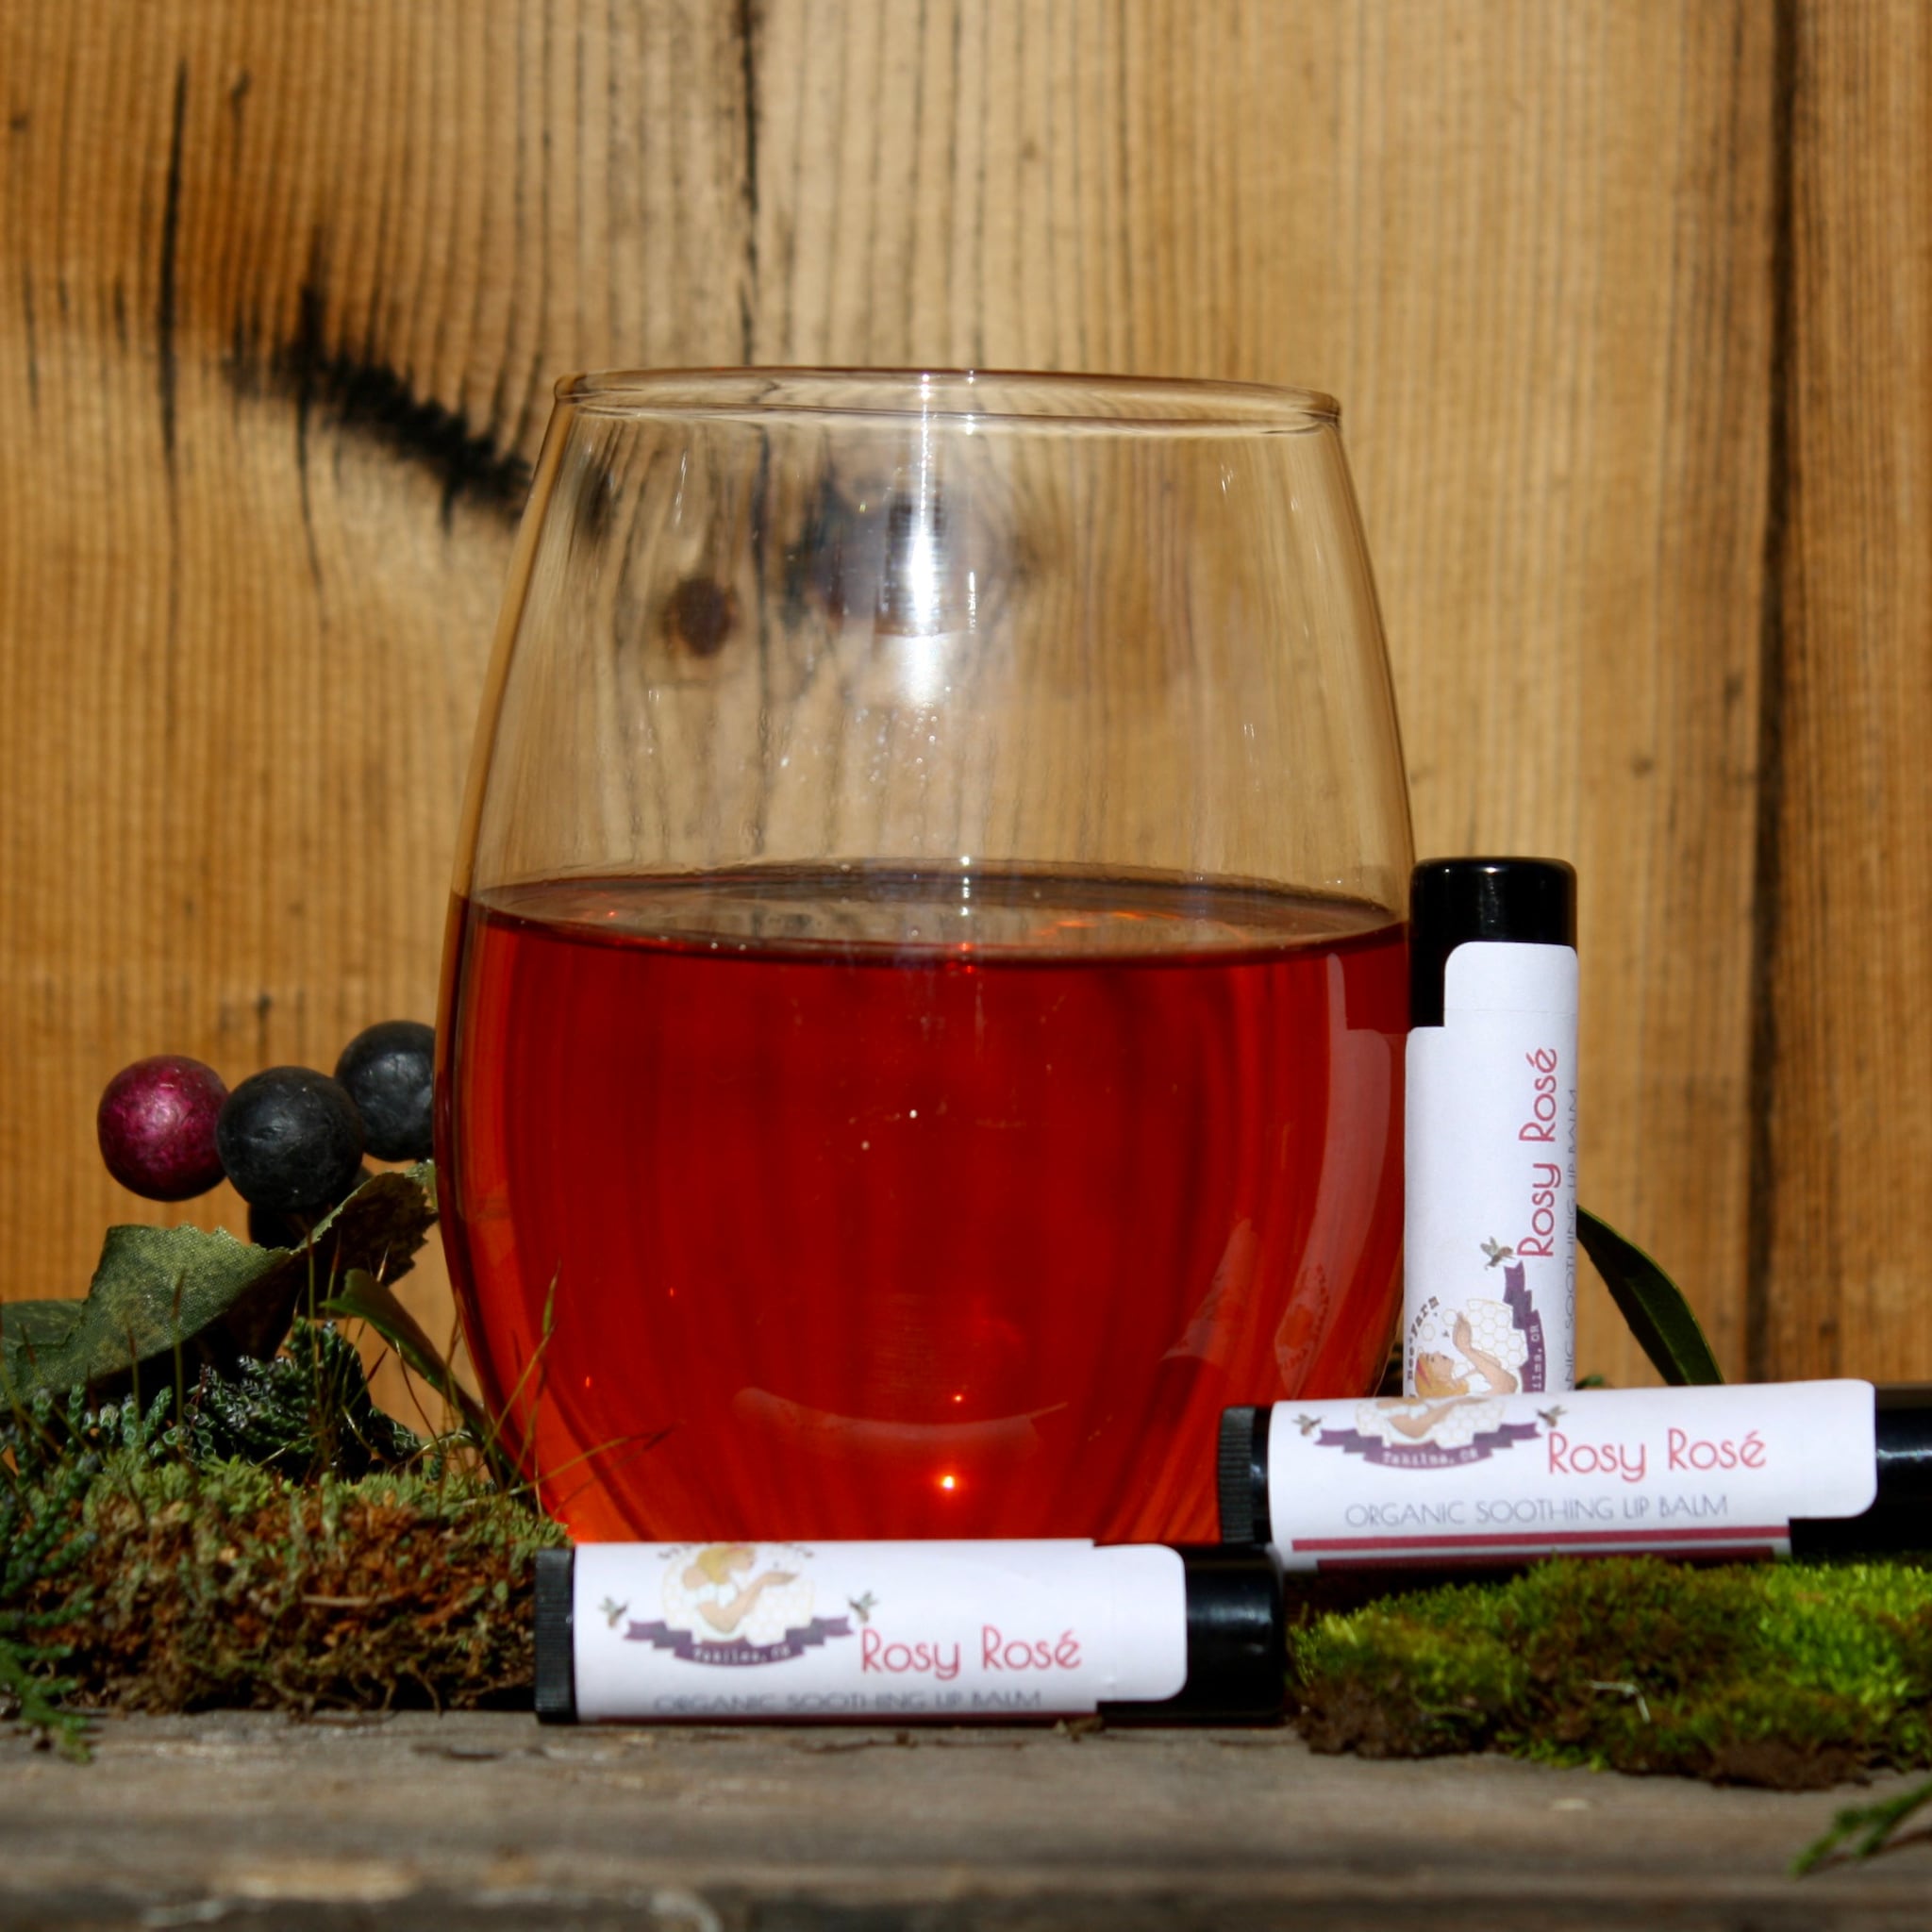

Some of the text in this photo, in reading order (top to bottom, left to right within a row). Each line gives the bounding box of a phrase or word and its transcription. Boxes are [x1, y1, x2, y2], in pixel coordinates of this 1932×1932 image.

[1517, 1048, 1561, 1257] Rosy Rosé
[1567, 1163, 1576, 1189] LIP
[1565, 1197, 1576, 1329] SOOTHING
[1548, 1427, 1767, 1483] Rosy Rosé
[1344, 1495, 1728, 1527] ORGANIC SOOTHING LIP BALM
[861, 1624, 1082, 1681] Rosy Rosé
